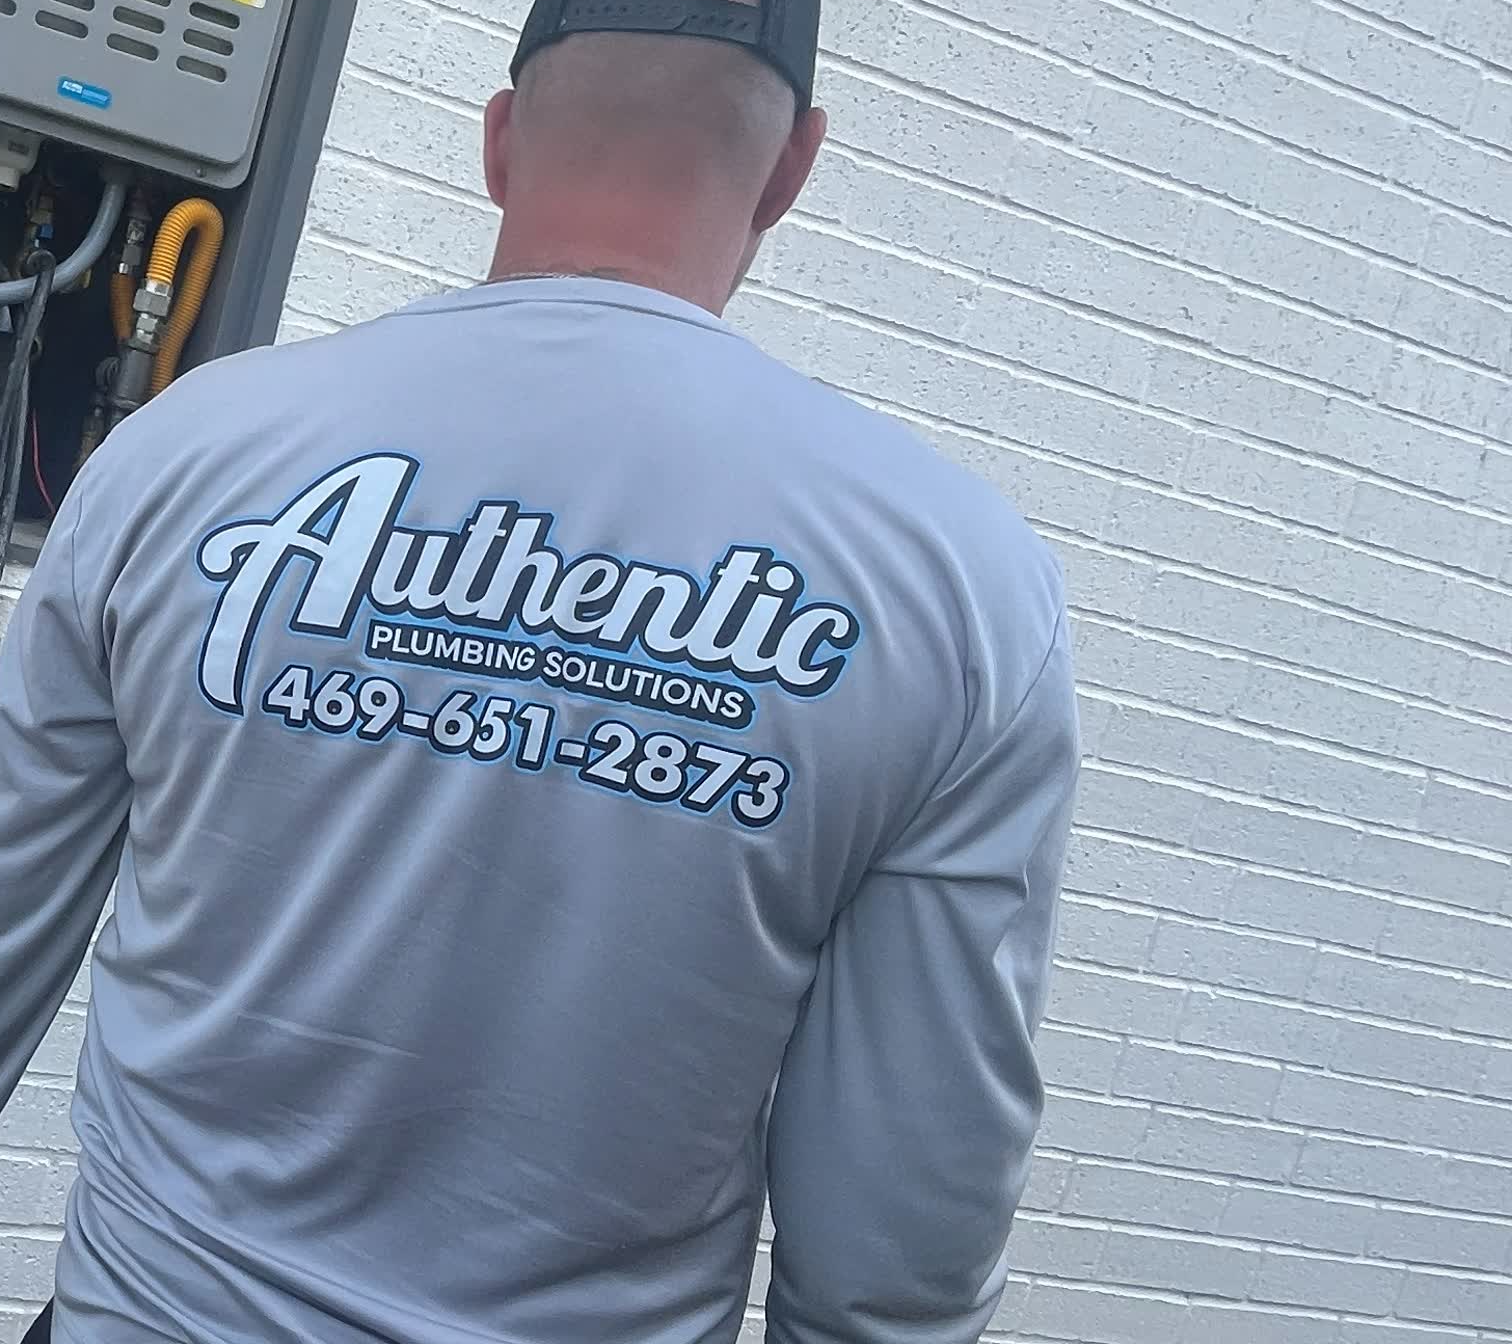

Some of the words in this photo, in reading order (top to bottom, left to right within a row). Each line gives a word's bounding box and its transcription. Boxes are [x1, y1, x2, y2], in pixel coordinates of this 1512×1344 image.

[198, 453, 859, 713] Authentic
[265, 665, 787, 822] 469-651-2873
[370, 624, 536, 672] PLUMBING
[543, 651, 745, 719] SOLUTIONS
